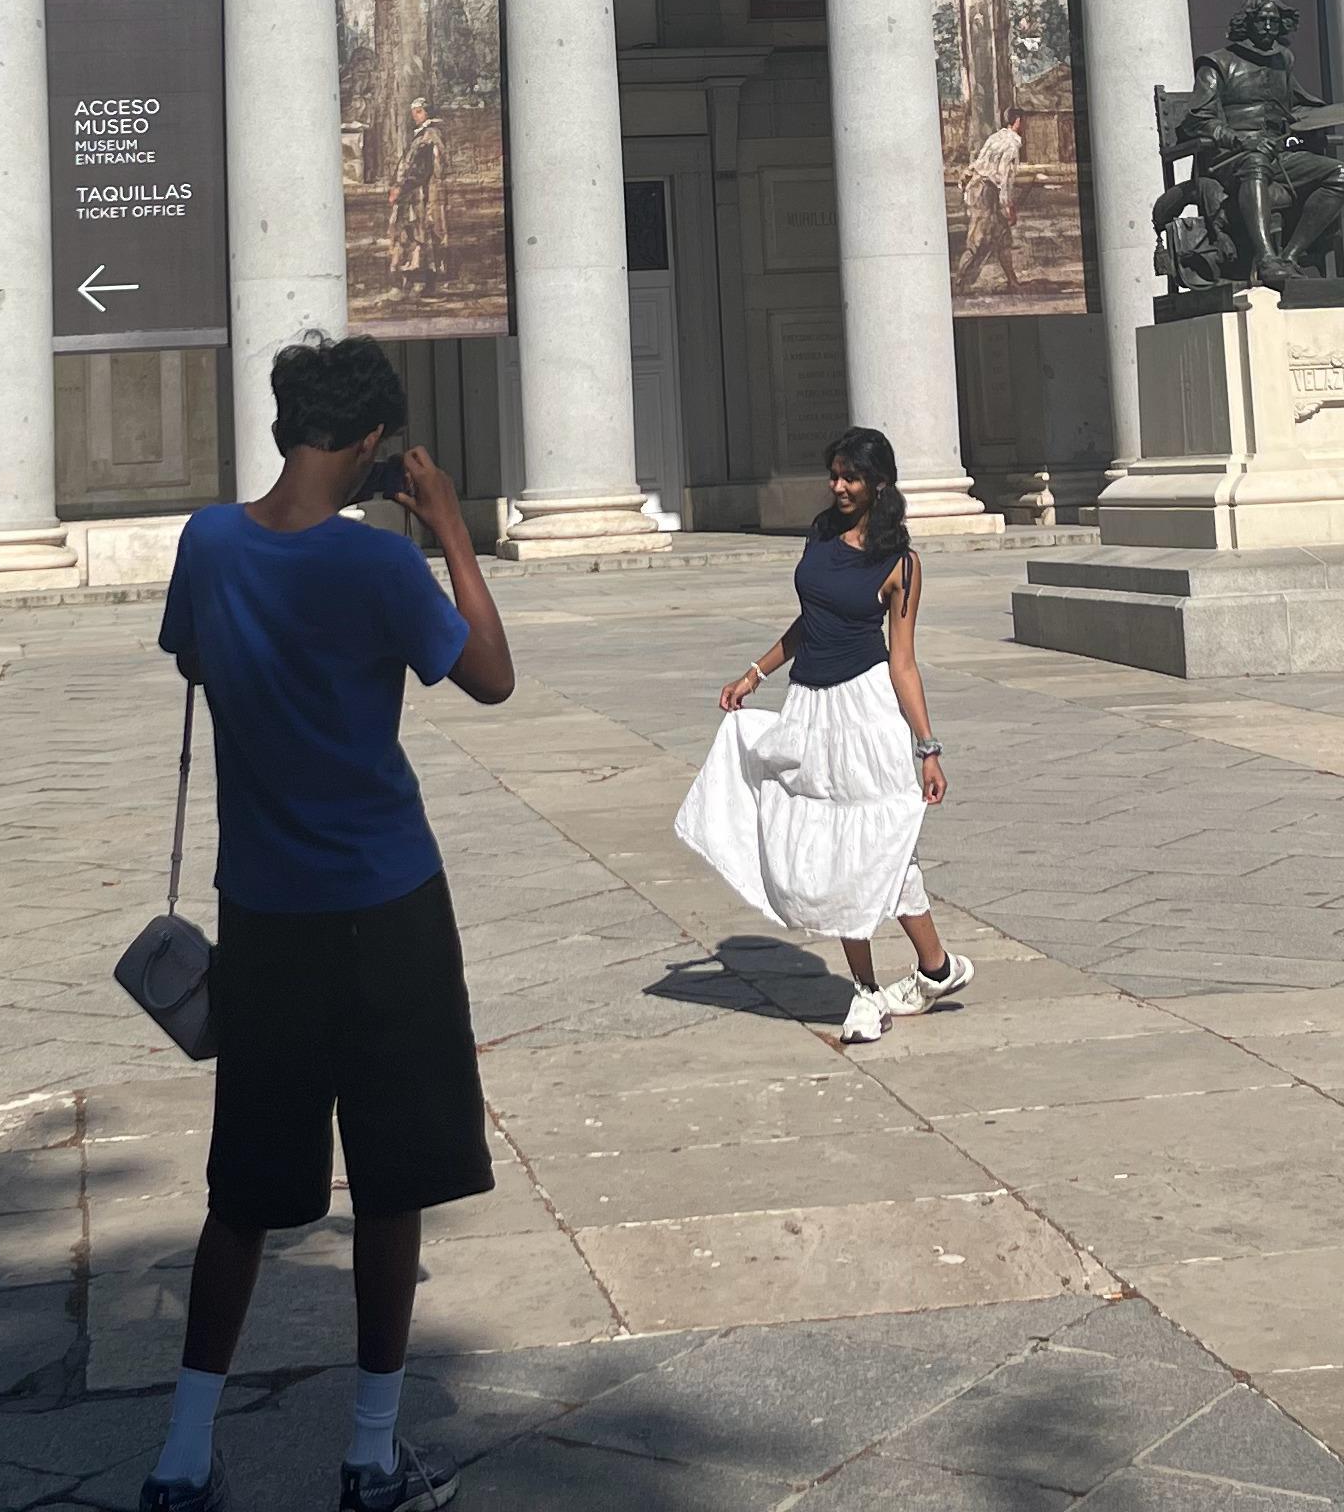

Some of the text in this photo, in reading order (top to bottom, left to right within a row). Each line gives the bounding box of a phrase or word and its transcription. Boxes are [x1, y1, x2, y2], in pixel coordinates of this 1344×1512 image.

[74, 98, 160, 116] ACCESO
[74, 118, 149, 135] MUSEO
[75, 139, 138, 152] MUSEUM
[75, 152, 156, 165] ENTRANCE
[75, 183, 192, 203] TAQUILLAS
[75, 204, 186, 220] TICKET OFFICE
